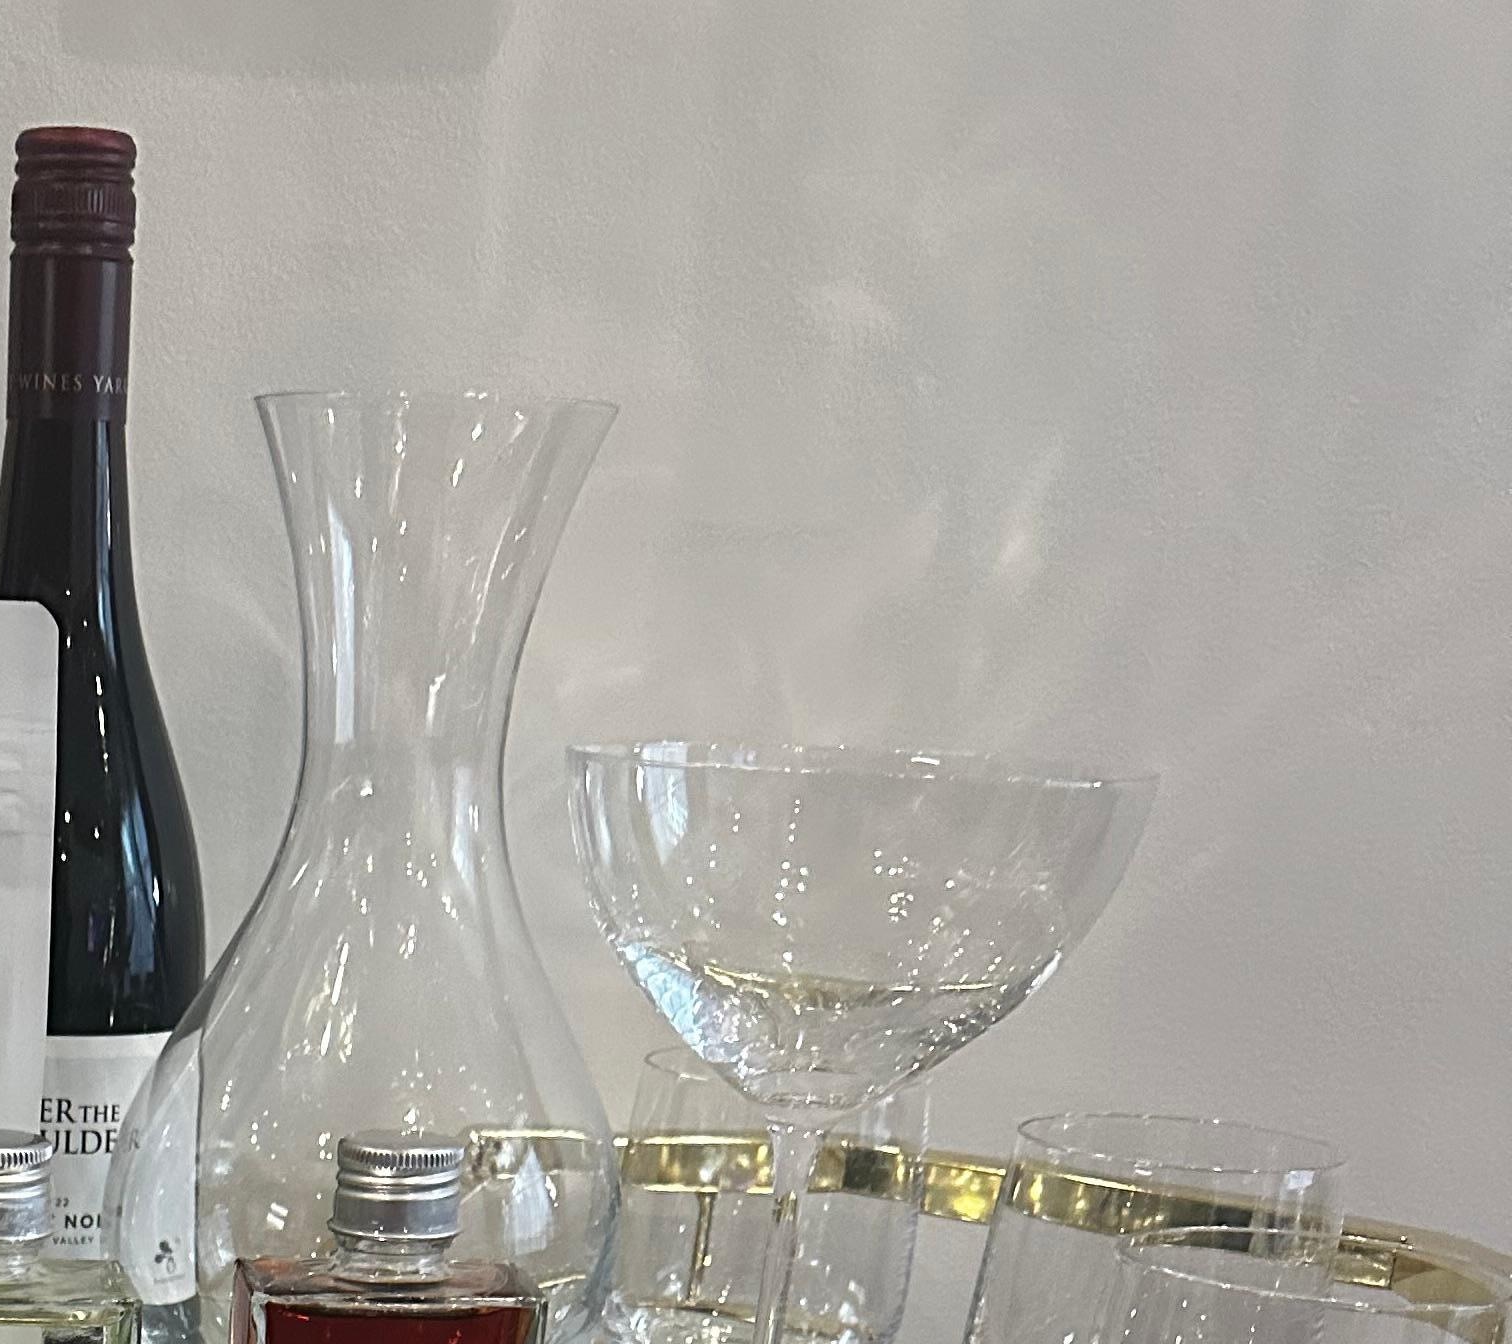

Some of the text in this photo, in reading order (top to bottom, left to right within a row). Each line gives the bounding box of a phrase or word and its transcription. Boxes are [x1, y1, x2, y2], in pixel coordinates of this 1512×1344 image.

[18, 374, 83, 392] WINES
[40, 1098, 120, 1124] ER THE
[64, 1215, 101, 1229] NOI
[53, 1236, 94, 1246] VALLEY
